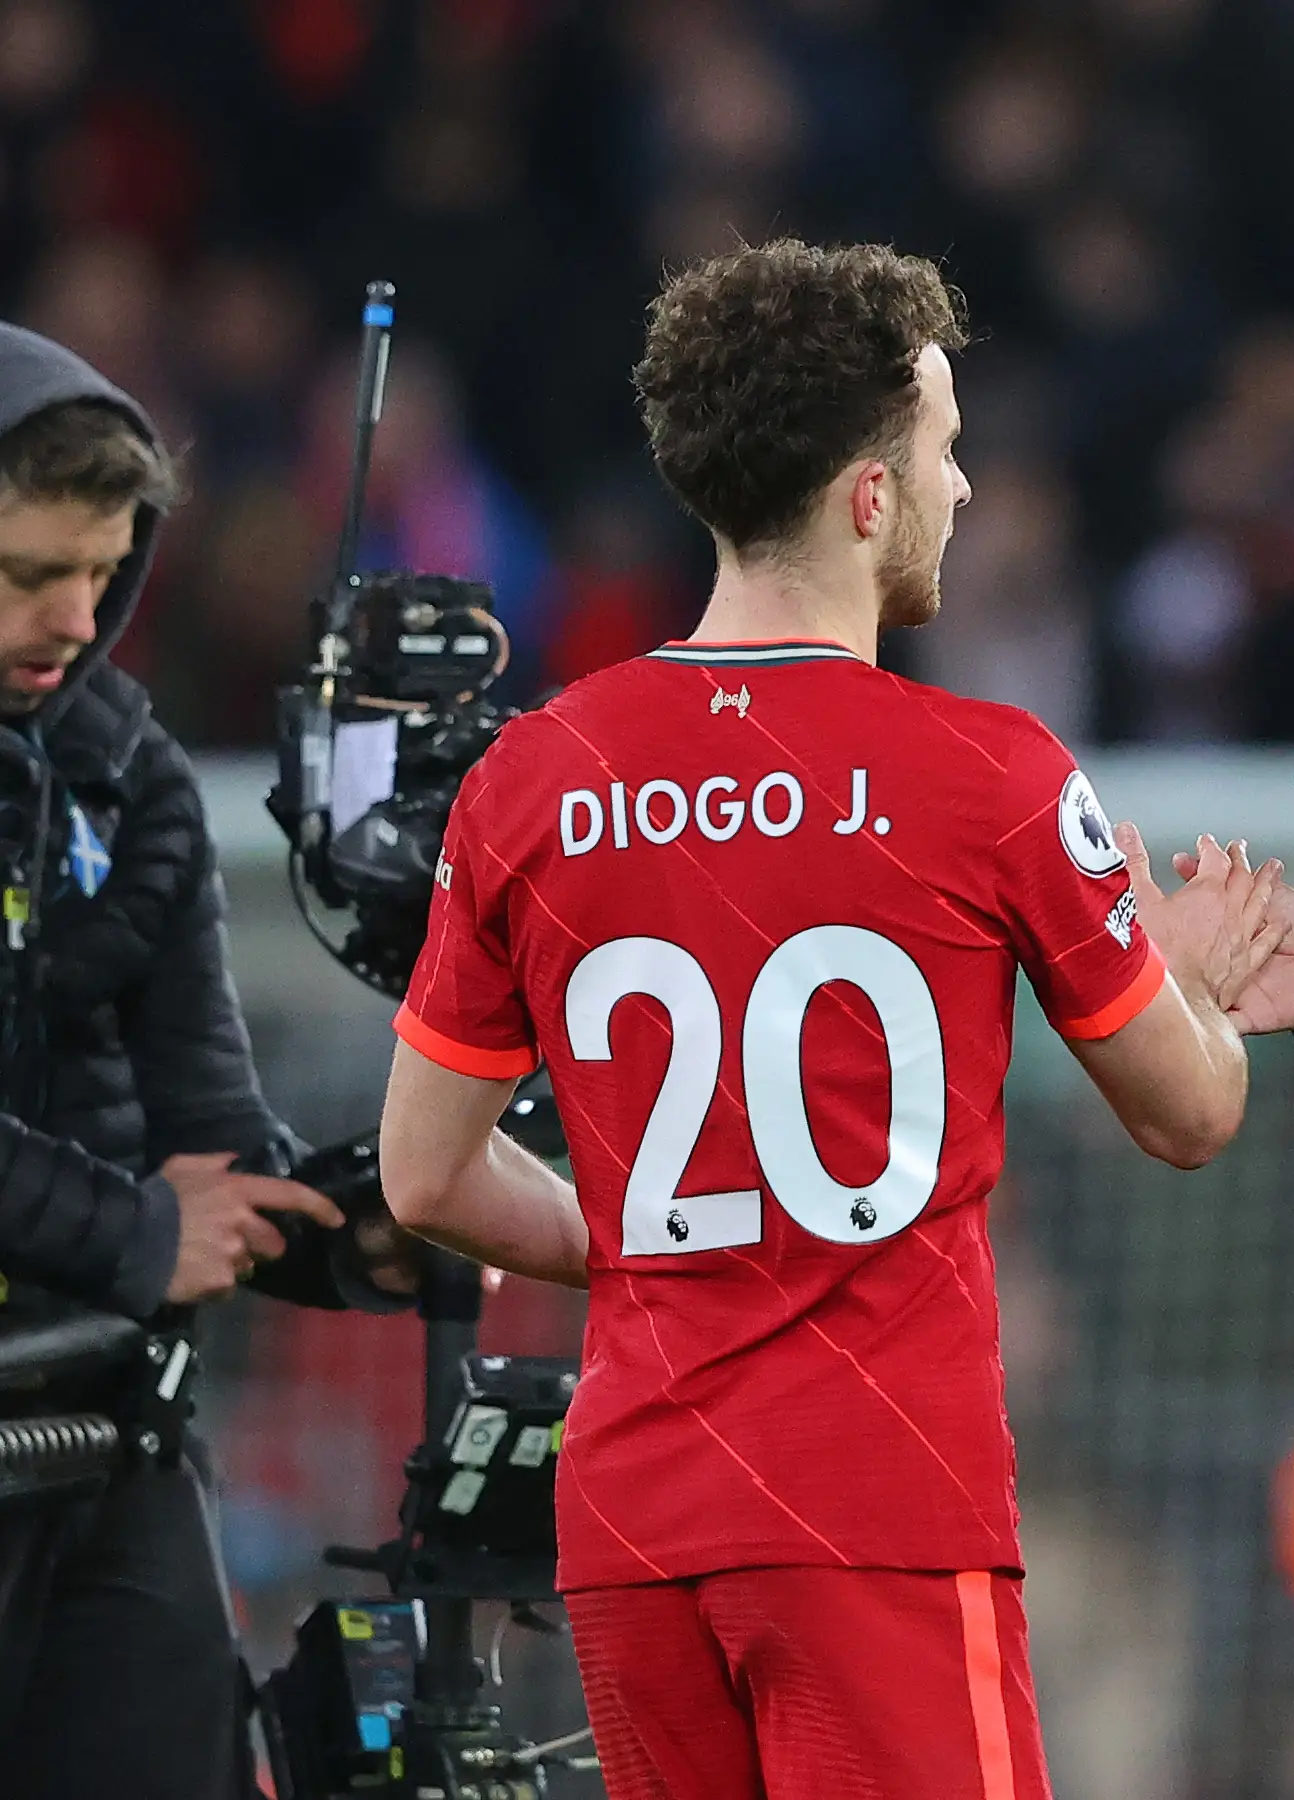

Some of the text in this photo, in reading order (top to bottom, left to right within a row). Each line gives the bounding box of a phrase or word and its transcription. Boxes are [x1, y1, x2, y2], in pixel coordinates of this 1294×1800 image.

[723, 693, 739, 707] 96
[560, 768, 892, 858] DIOGO J.
[565, 924, 947, 1258] 20
